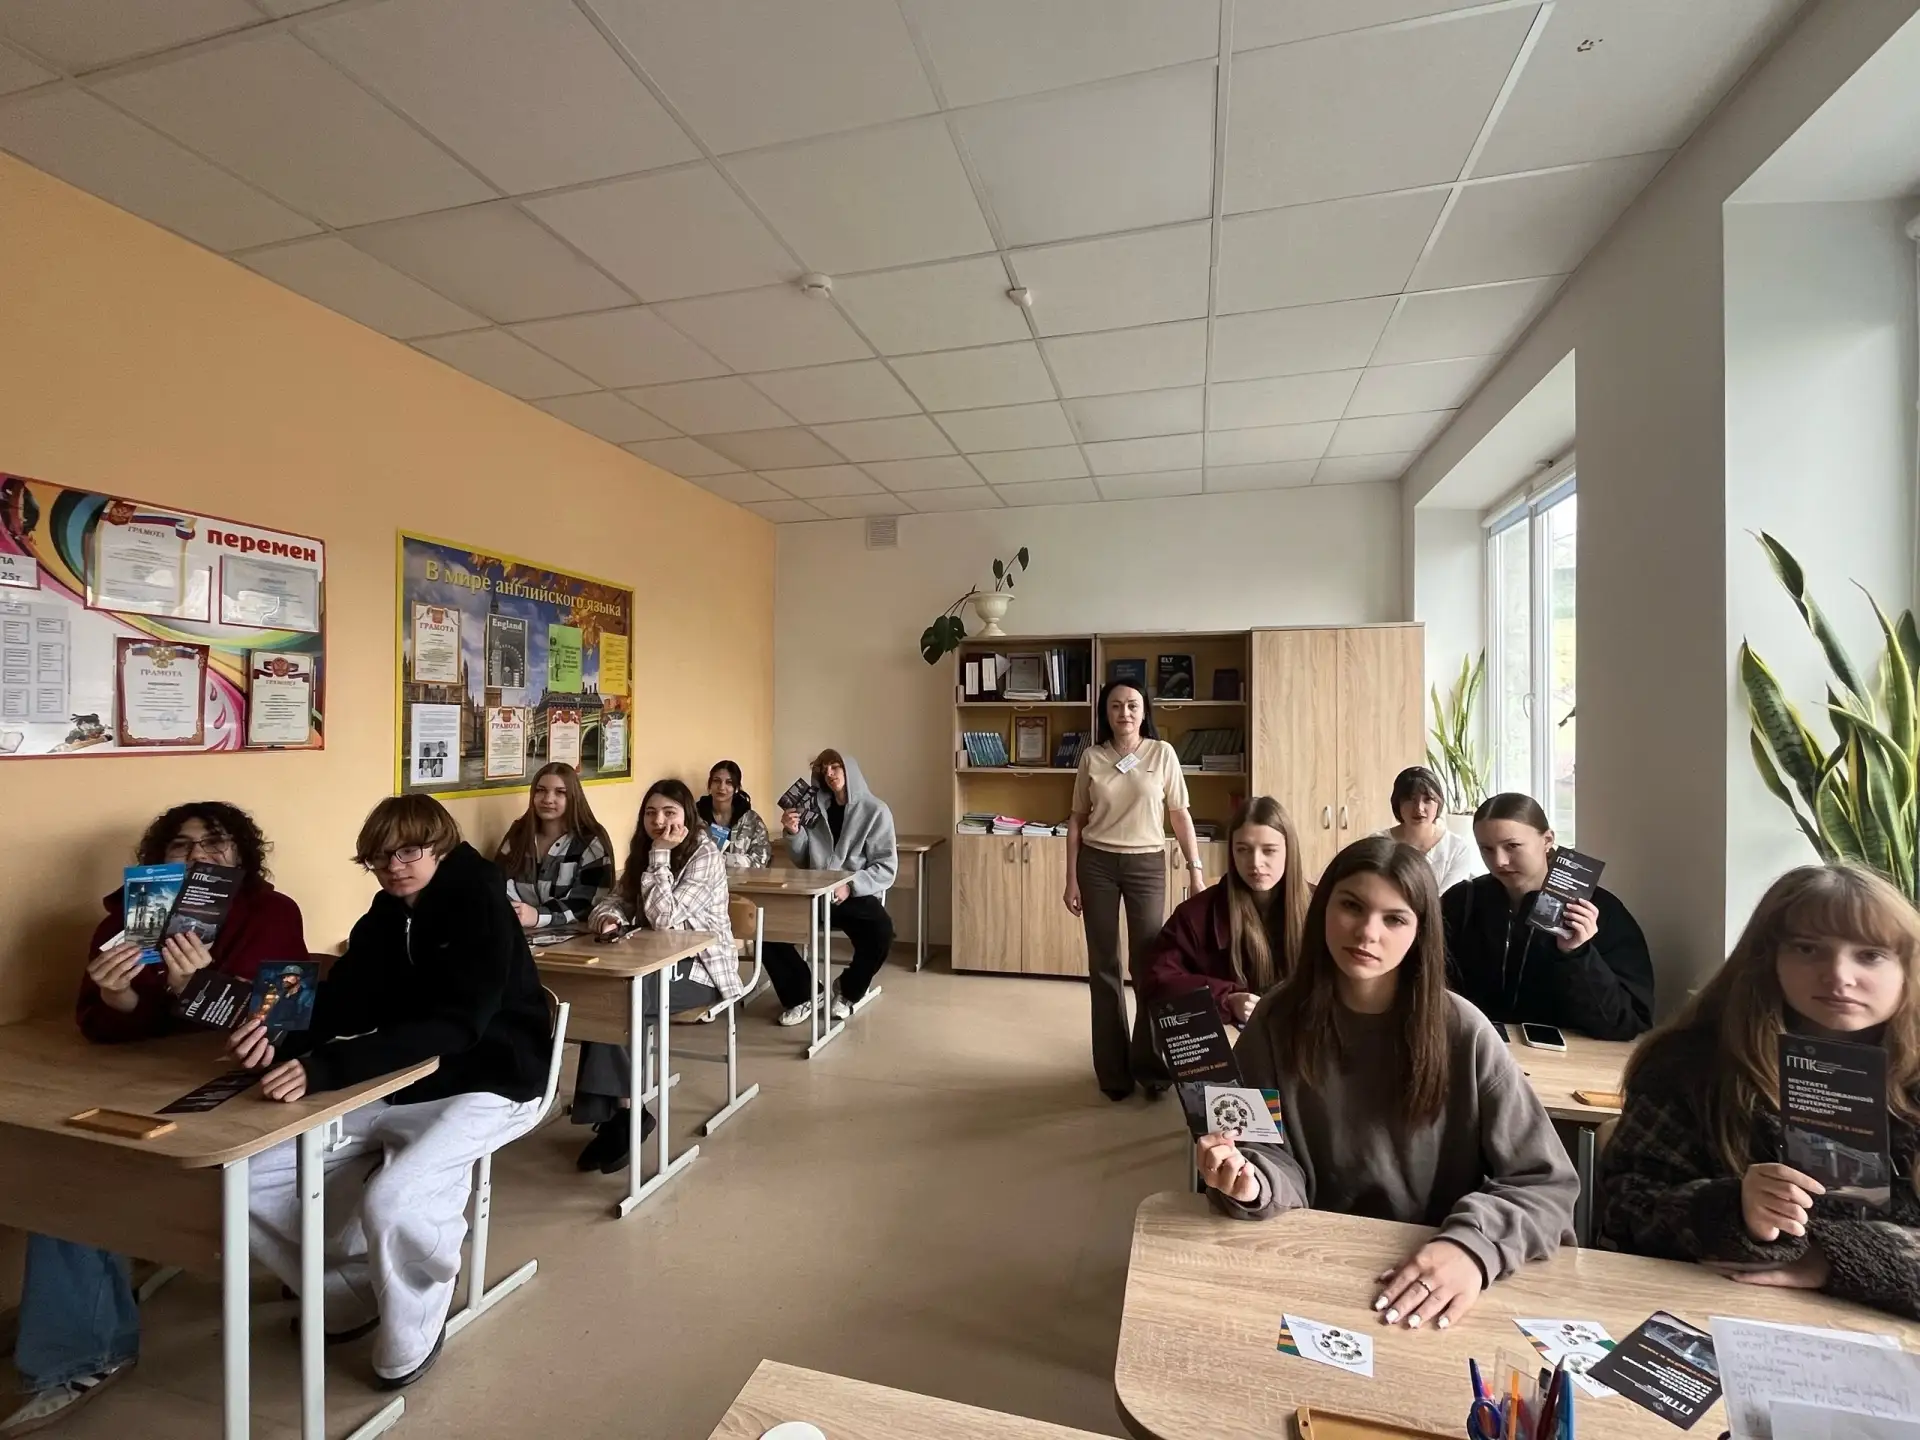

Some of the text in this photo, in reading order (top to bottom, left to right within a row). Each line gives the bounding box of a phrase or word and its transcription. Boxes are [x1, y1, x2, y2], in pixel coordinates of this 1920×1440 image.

[128, 526, 165, 538] ГРАМОТА
[207, 528, 316, 563] перемен
[425, 560, 622, 617] В мире английского языка
[420, 622, 454, 632] ГРАМОТА
[492, 618, 523, 631] England
[140, 669, 183, 677] ГРАМОТА
